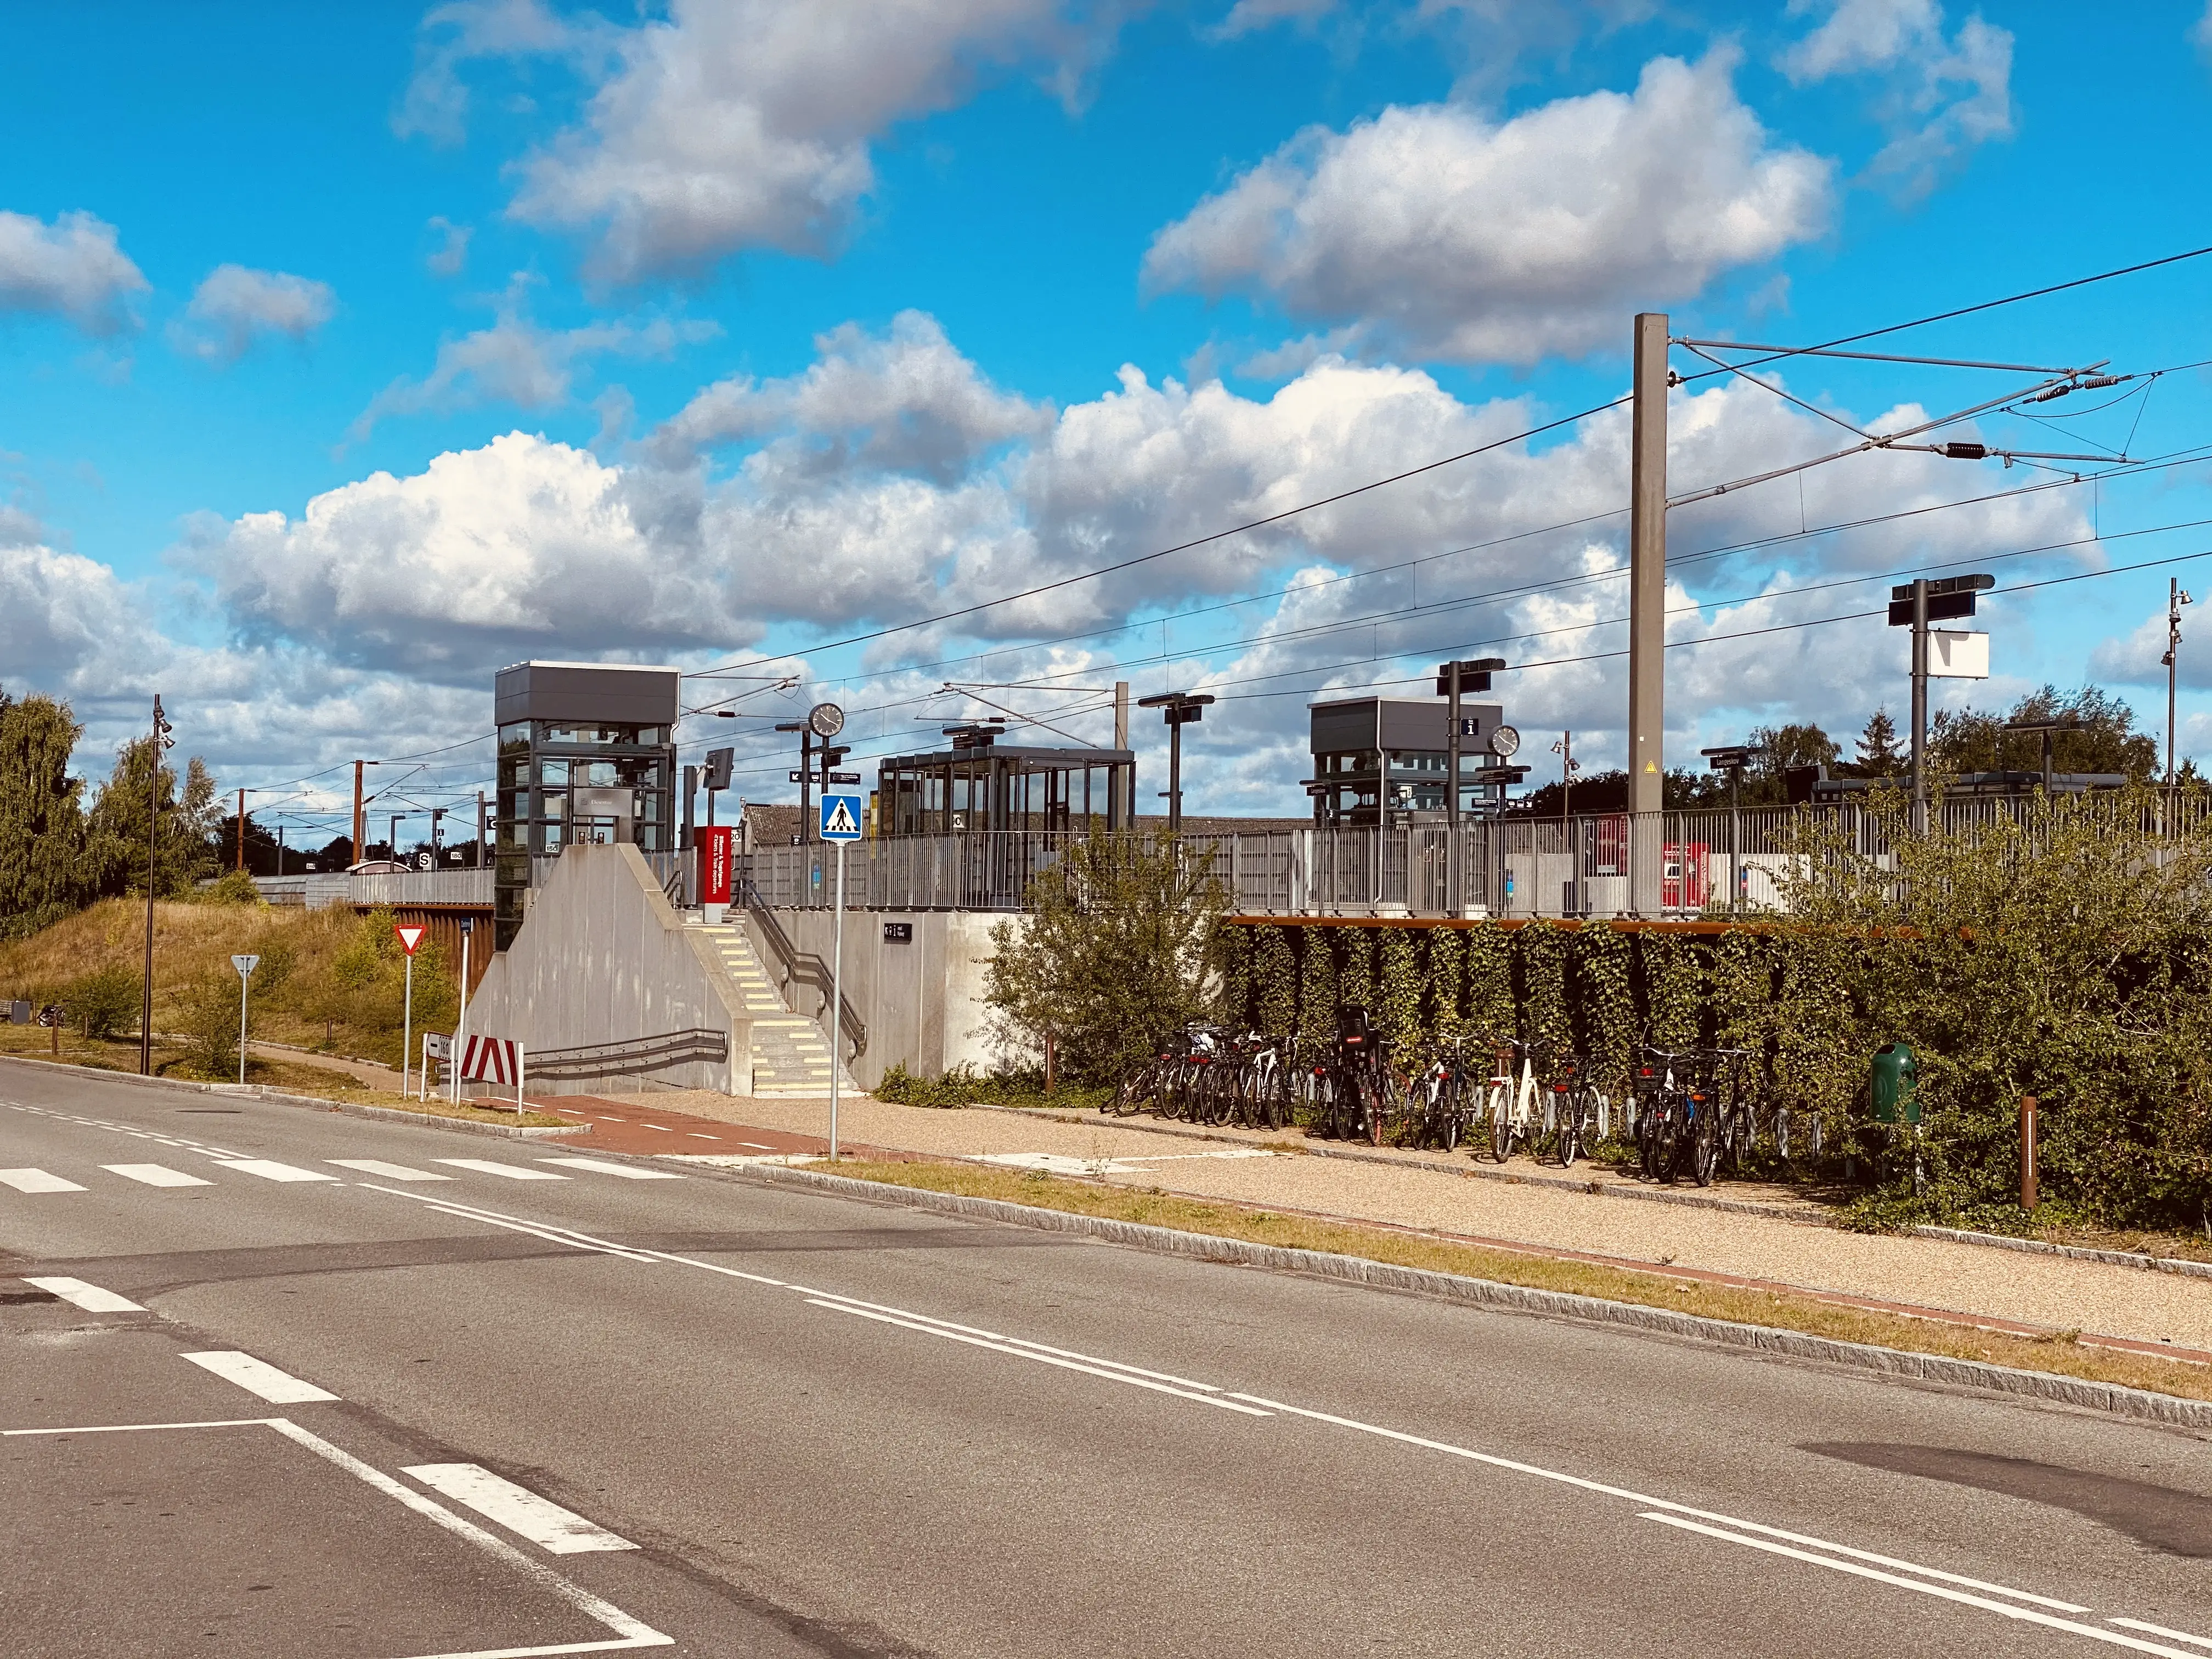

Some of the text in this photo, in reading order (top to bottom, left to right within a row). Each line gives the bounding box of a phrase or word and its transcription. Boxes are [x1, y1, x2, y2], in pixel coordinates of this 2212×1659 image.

[1468, 725, 1474, 734] 1
[1717, 758, 1739, 766] Langeskov
[420, 855, 428, 865] S
[441, 1042, 449, 1055] 160
